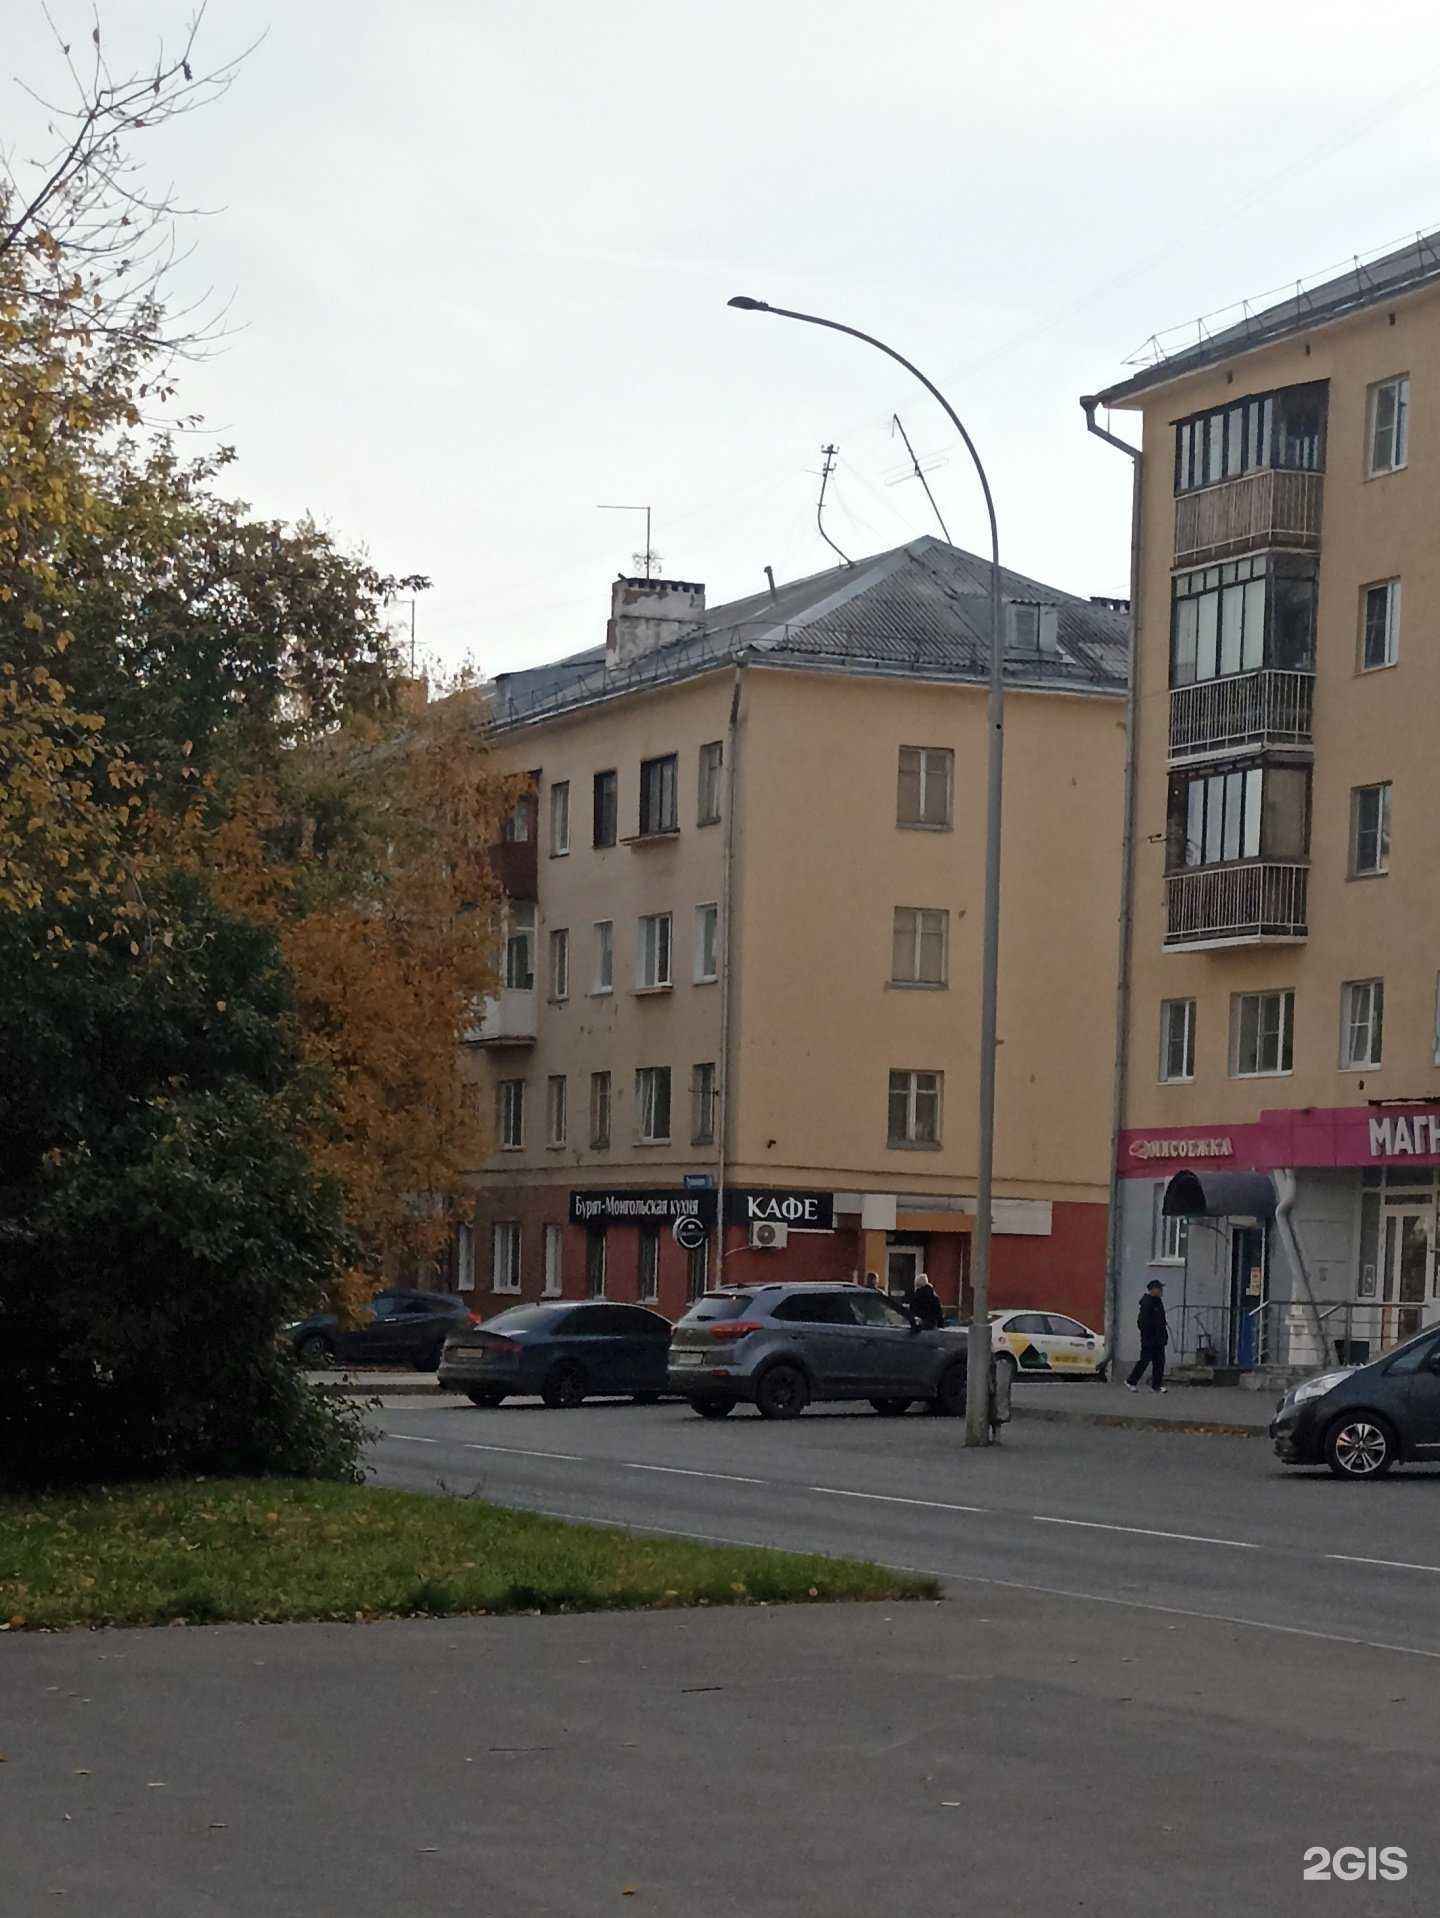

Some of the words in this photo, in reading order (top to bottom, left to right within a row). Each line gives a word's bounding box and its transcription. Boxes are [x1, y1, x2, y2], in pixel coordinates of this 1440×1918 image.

[575, 1195, 668, 1219] Бурят-Монгольская
[670, 1199, 699, 1217] кухня
[747, 1196, 818, 1220] КАФЕ
